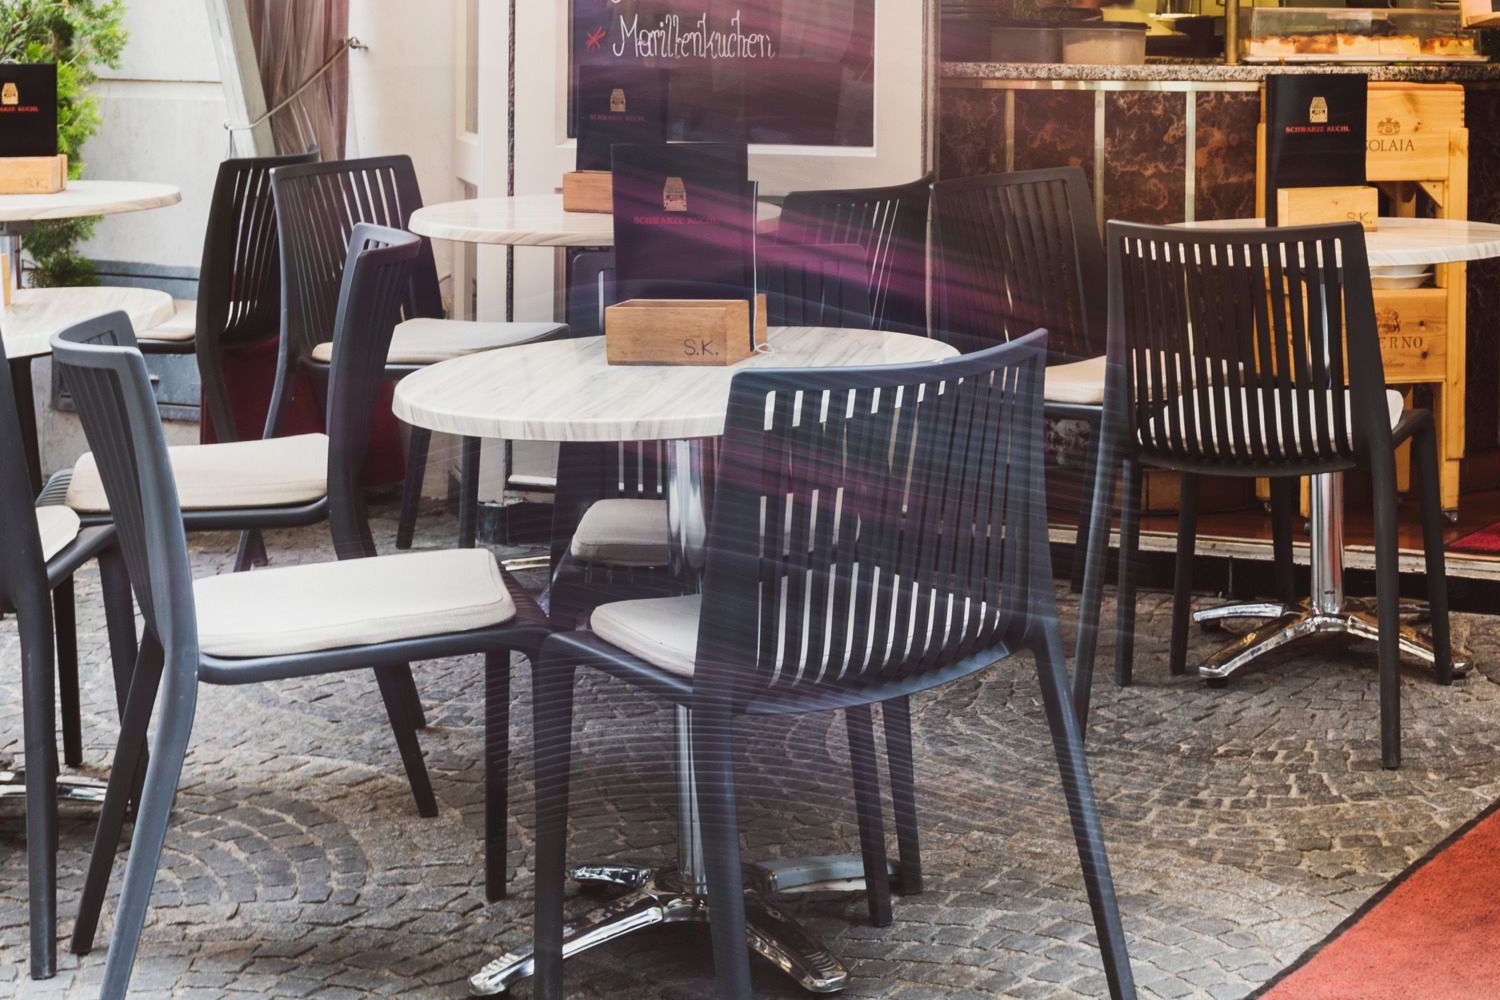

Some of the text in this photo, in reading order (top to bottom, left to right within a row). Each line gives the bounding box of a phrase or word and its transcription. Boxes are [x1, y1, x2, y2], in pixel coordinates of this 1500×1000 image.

[613, 10, 776, 60] Marillenkuchen
[1366, 138, 1415, 152] OLAIA
[683, 339, 719, 356] S.K.
